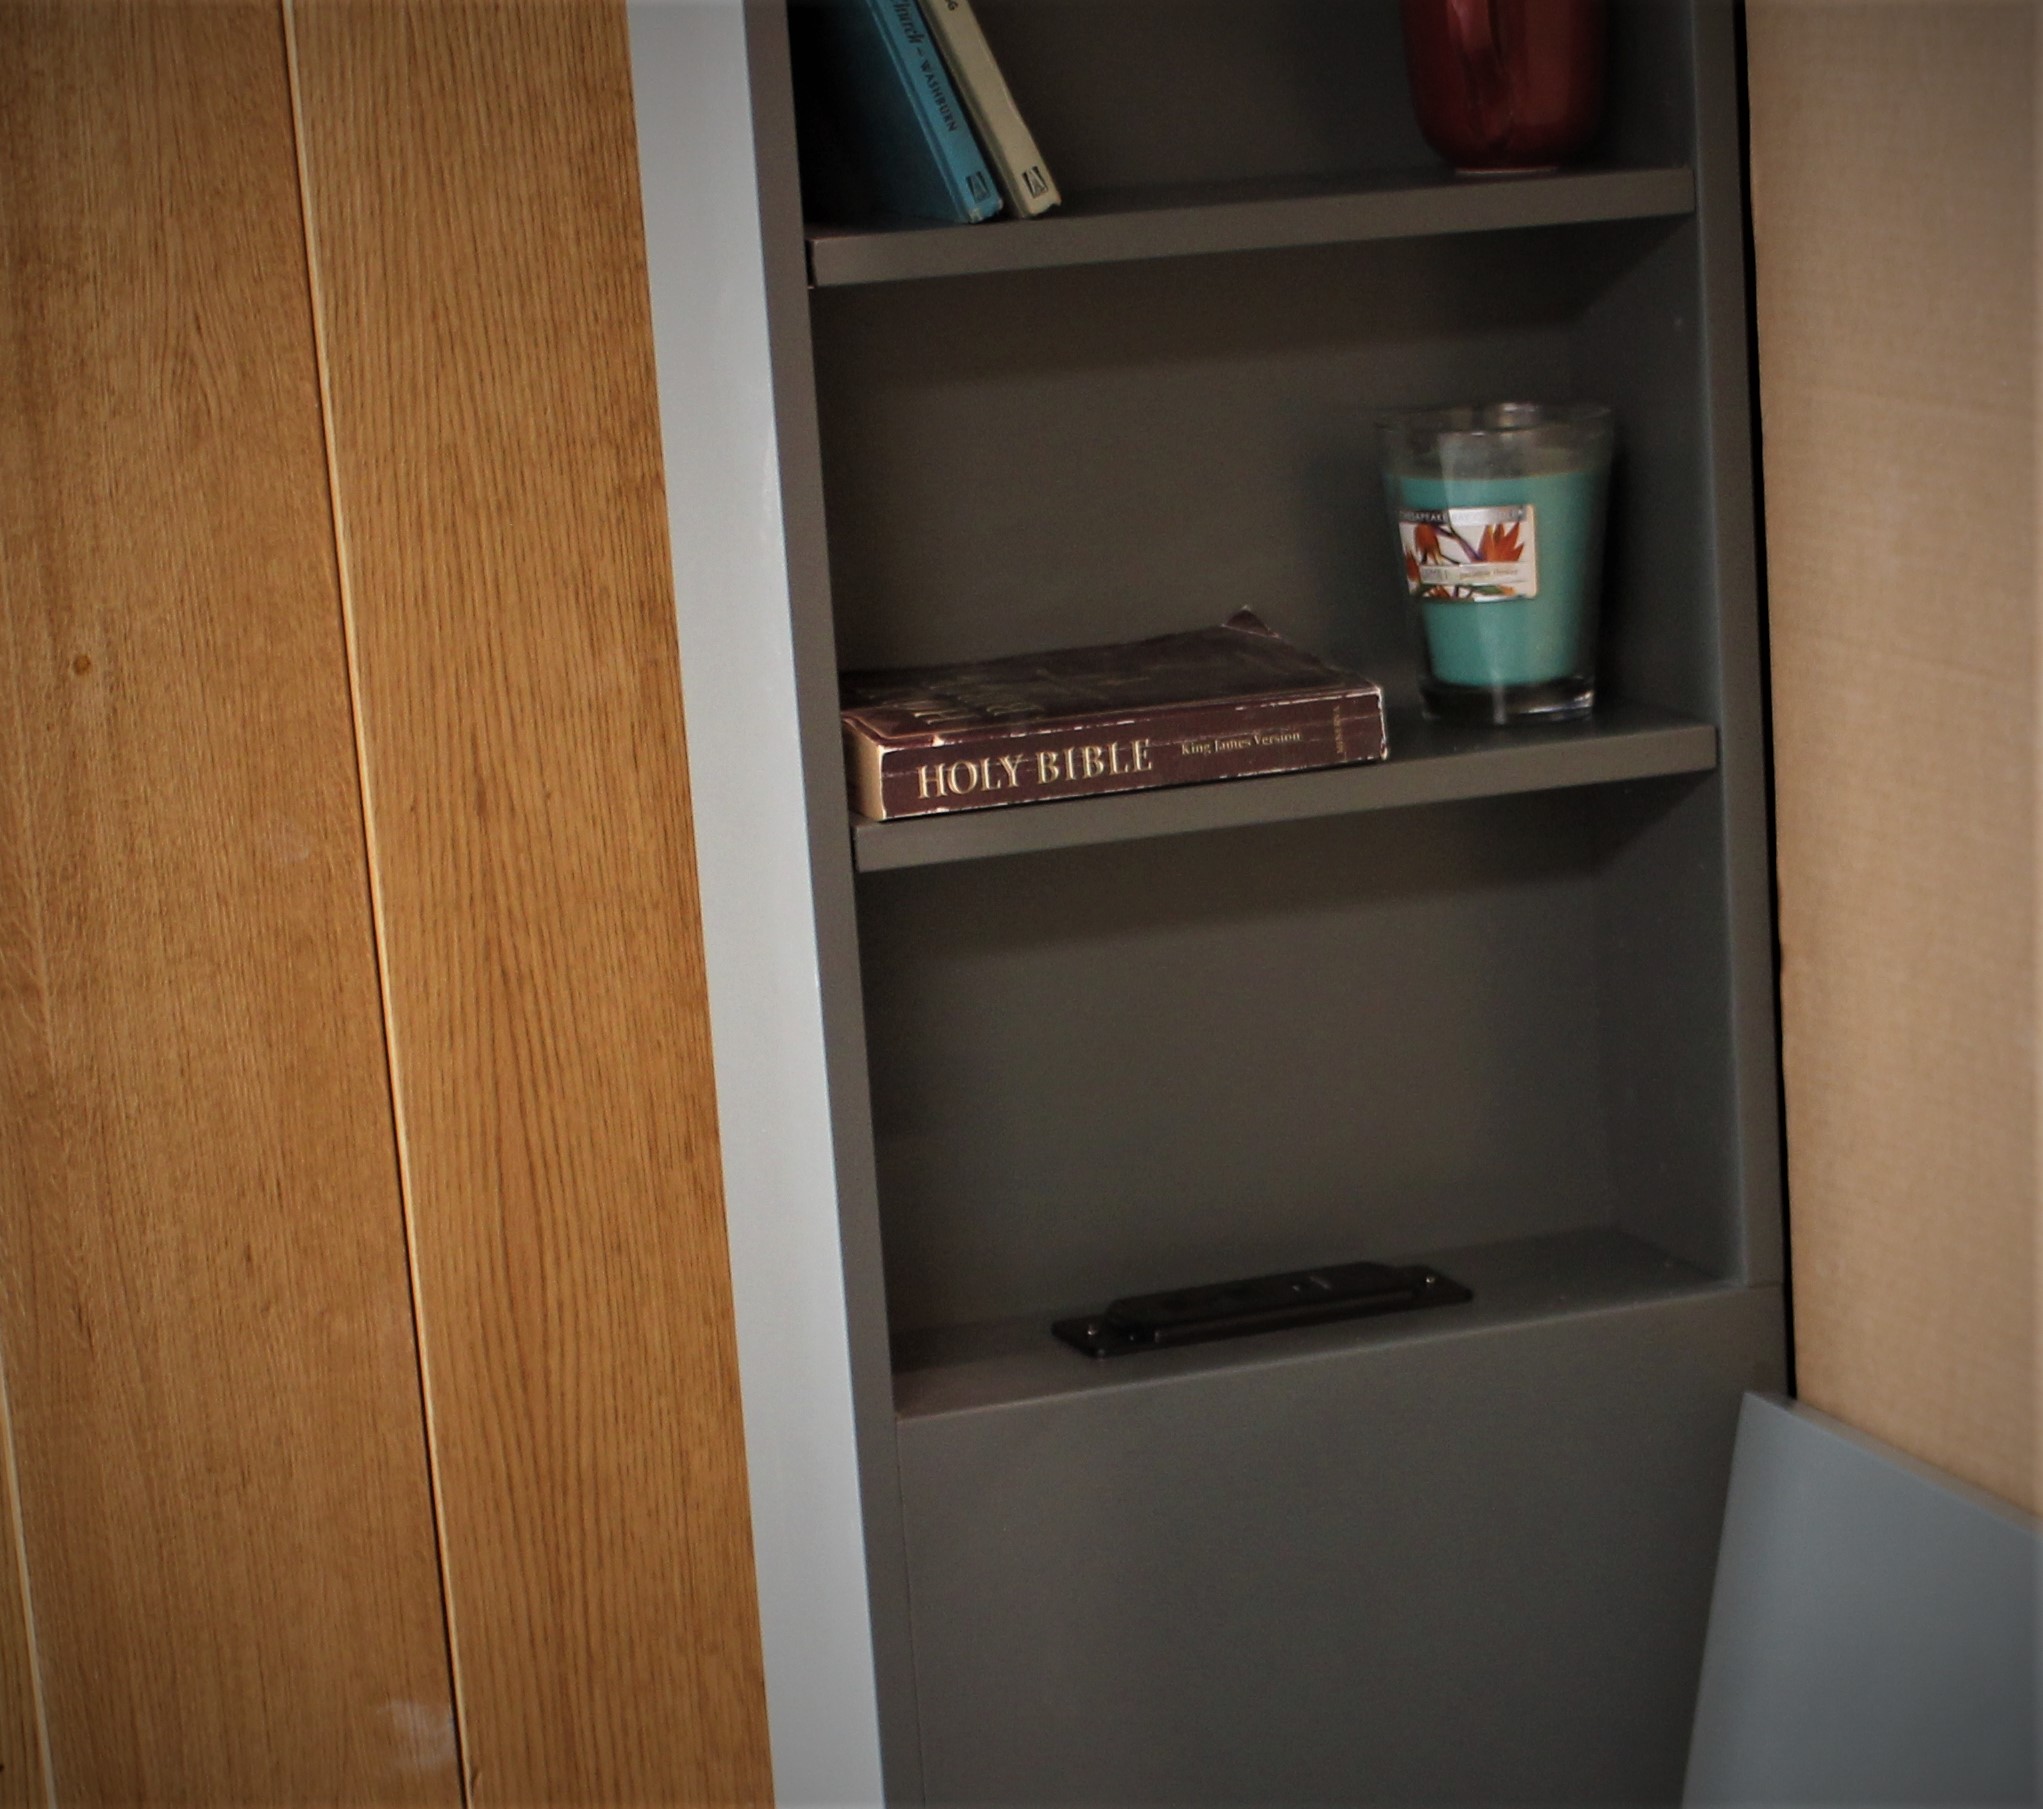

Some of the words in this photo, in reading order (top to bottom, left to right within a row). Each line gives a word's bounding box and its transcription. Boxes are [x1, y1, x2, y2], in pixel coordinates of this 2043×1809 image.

[892, 0, 925, 44] hurch
[920, 60, 957, 132] WASHBURN
[917, 753, 1024, 799] HOLY
[1036, 738, 1153, 785] BIBLE
[1181, 741, 1212, 756] King
[1253, 731, 1301, 746] Version
